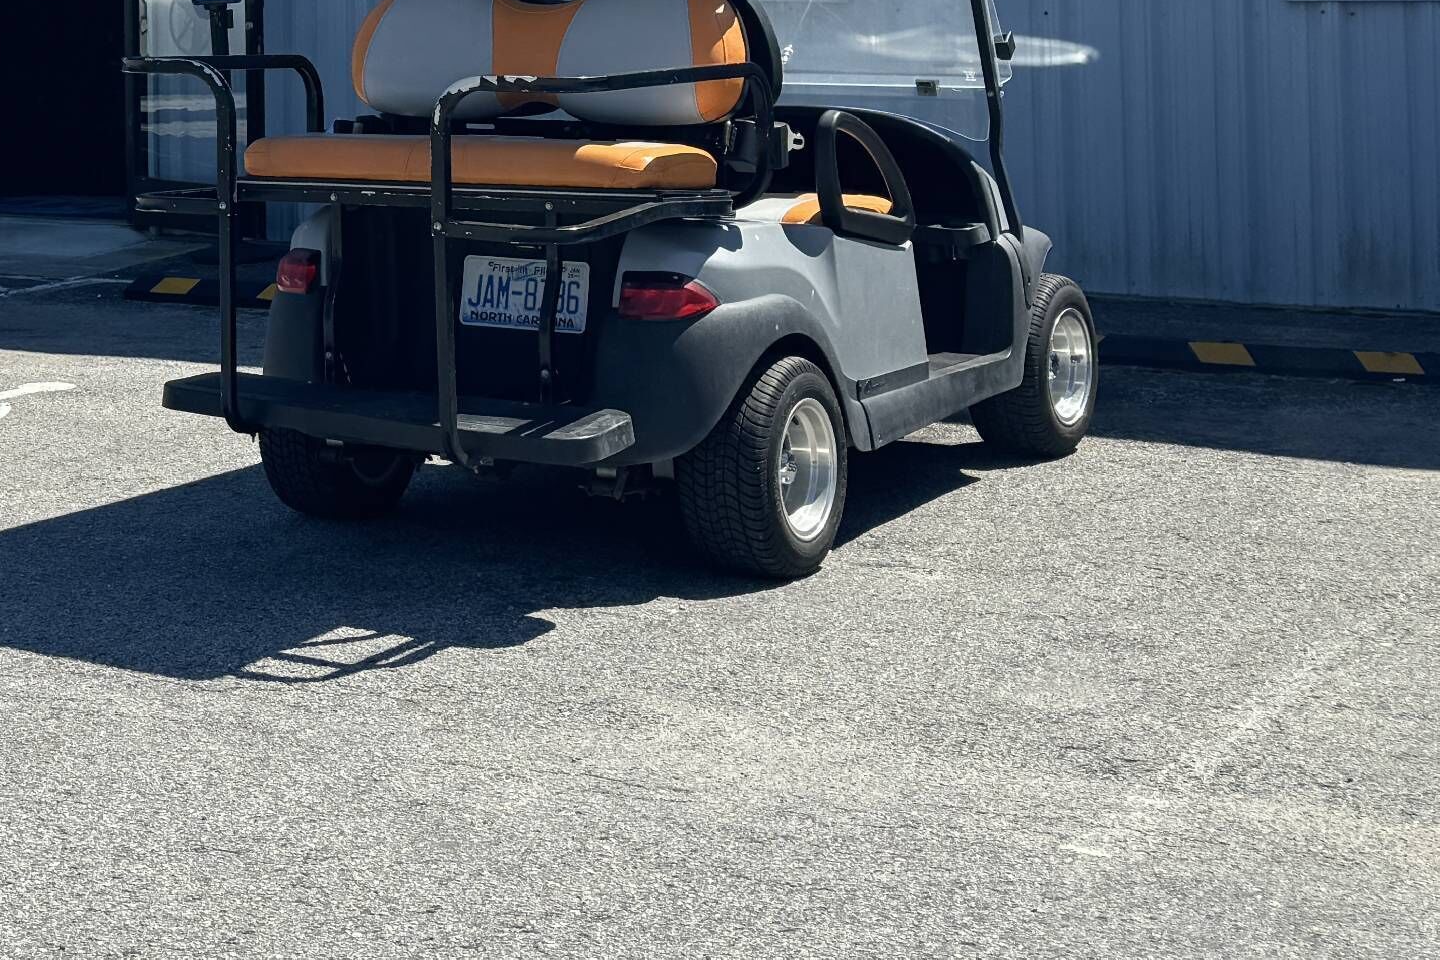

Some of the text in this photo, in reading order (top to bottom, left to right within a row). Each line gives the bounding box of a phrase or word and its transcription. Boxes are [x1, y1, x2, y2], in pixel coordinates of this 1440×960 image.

[467, 274, 580, 315] JAM-86
[470, 310, 575, 328] NORTH CARINA
